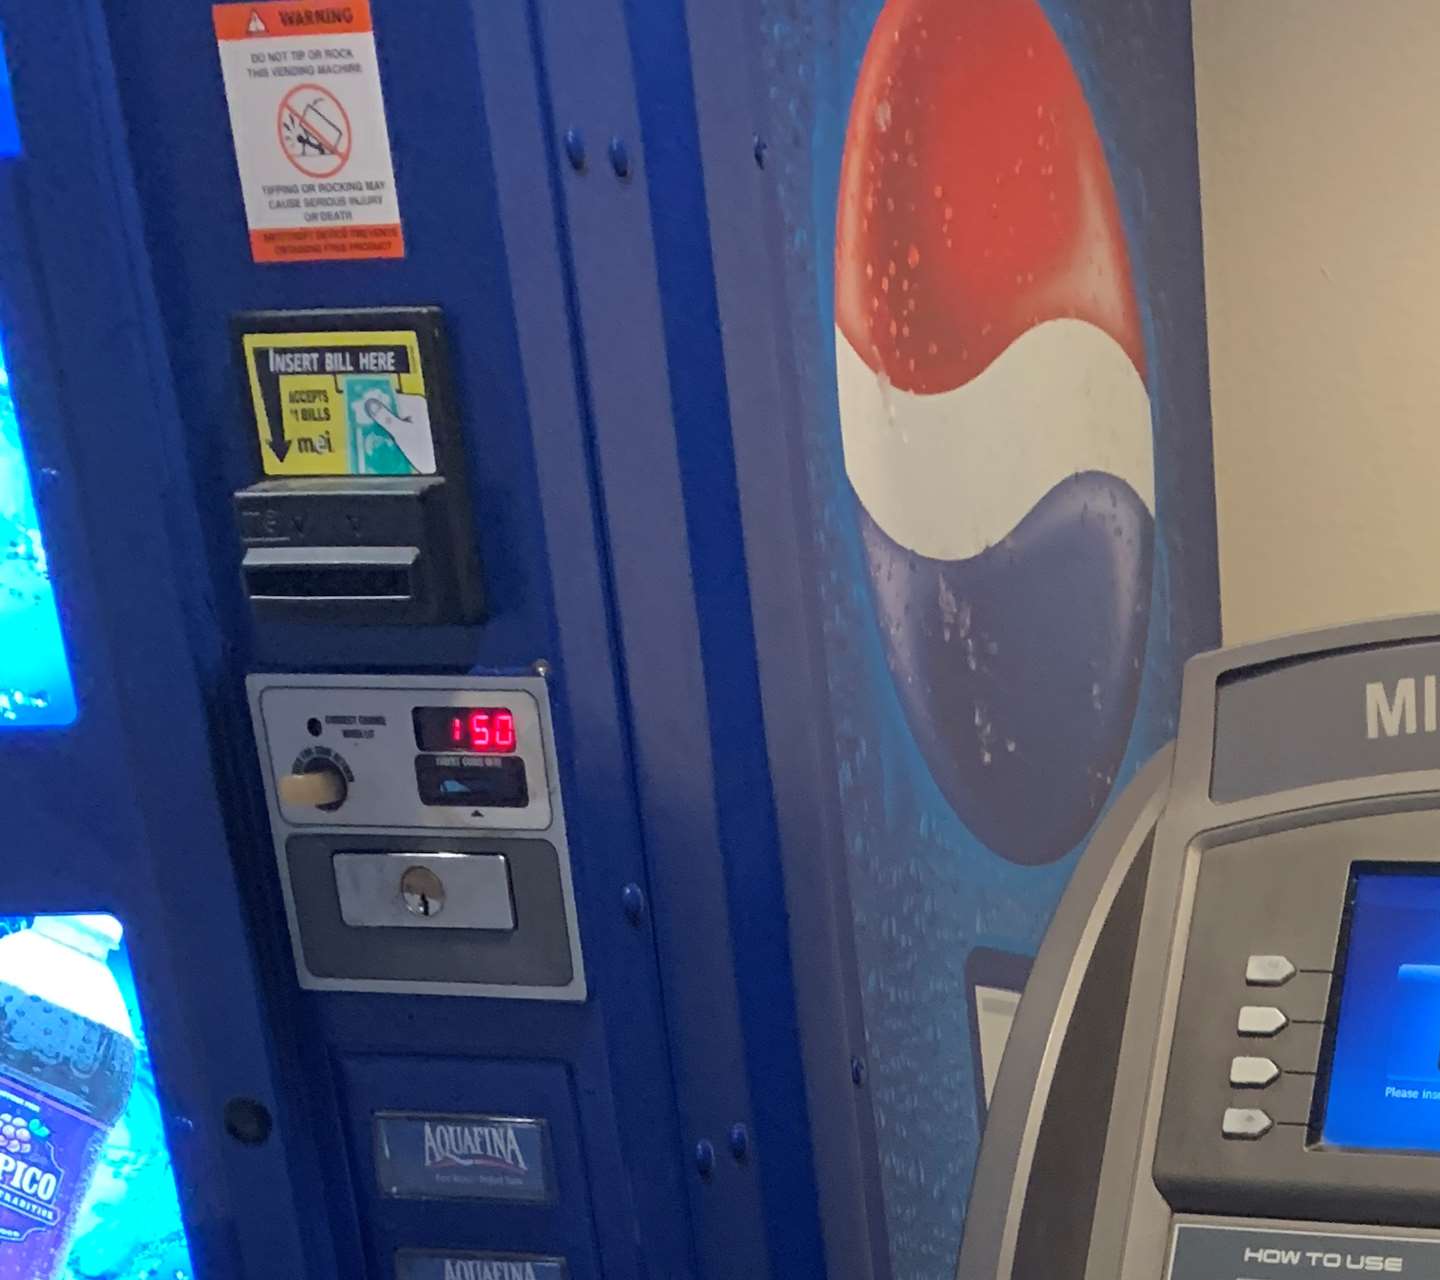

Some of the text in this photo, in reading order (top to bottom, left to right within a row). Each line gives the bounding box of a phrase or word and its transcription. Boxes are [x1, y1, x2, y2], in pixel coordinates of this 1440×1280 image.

[279, 8, 353, 26] WARNING
[251, 53, 266, 63] DO
[268, 52, 287, 62] NOT
[325, 49, 353, 59] ROCK
[272, 66, 316, 77] VENDING
[317, 63, 362, 75] MACHINE
[318, 182, 362, 193] ROCKING
[319, 210, 353, 221] DEATH
[268, 348, 396, 373] INSERT BILL HERE
[288, 390, 329, 404] ACCEPTS
[301, 407, 330, 422] BILLS
[1385, 1086, 1419, 1099] Please
[424, 1121, 528, 1170] AQUAFINA
[1243, 1246, 1404, 1273] HOW TO USE
